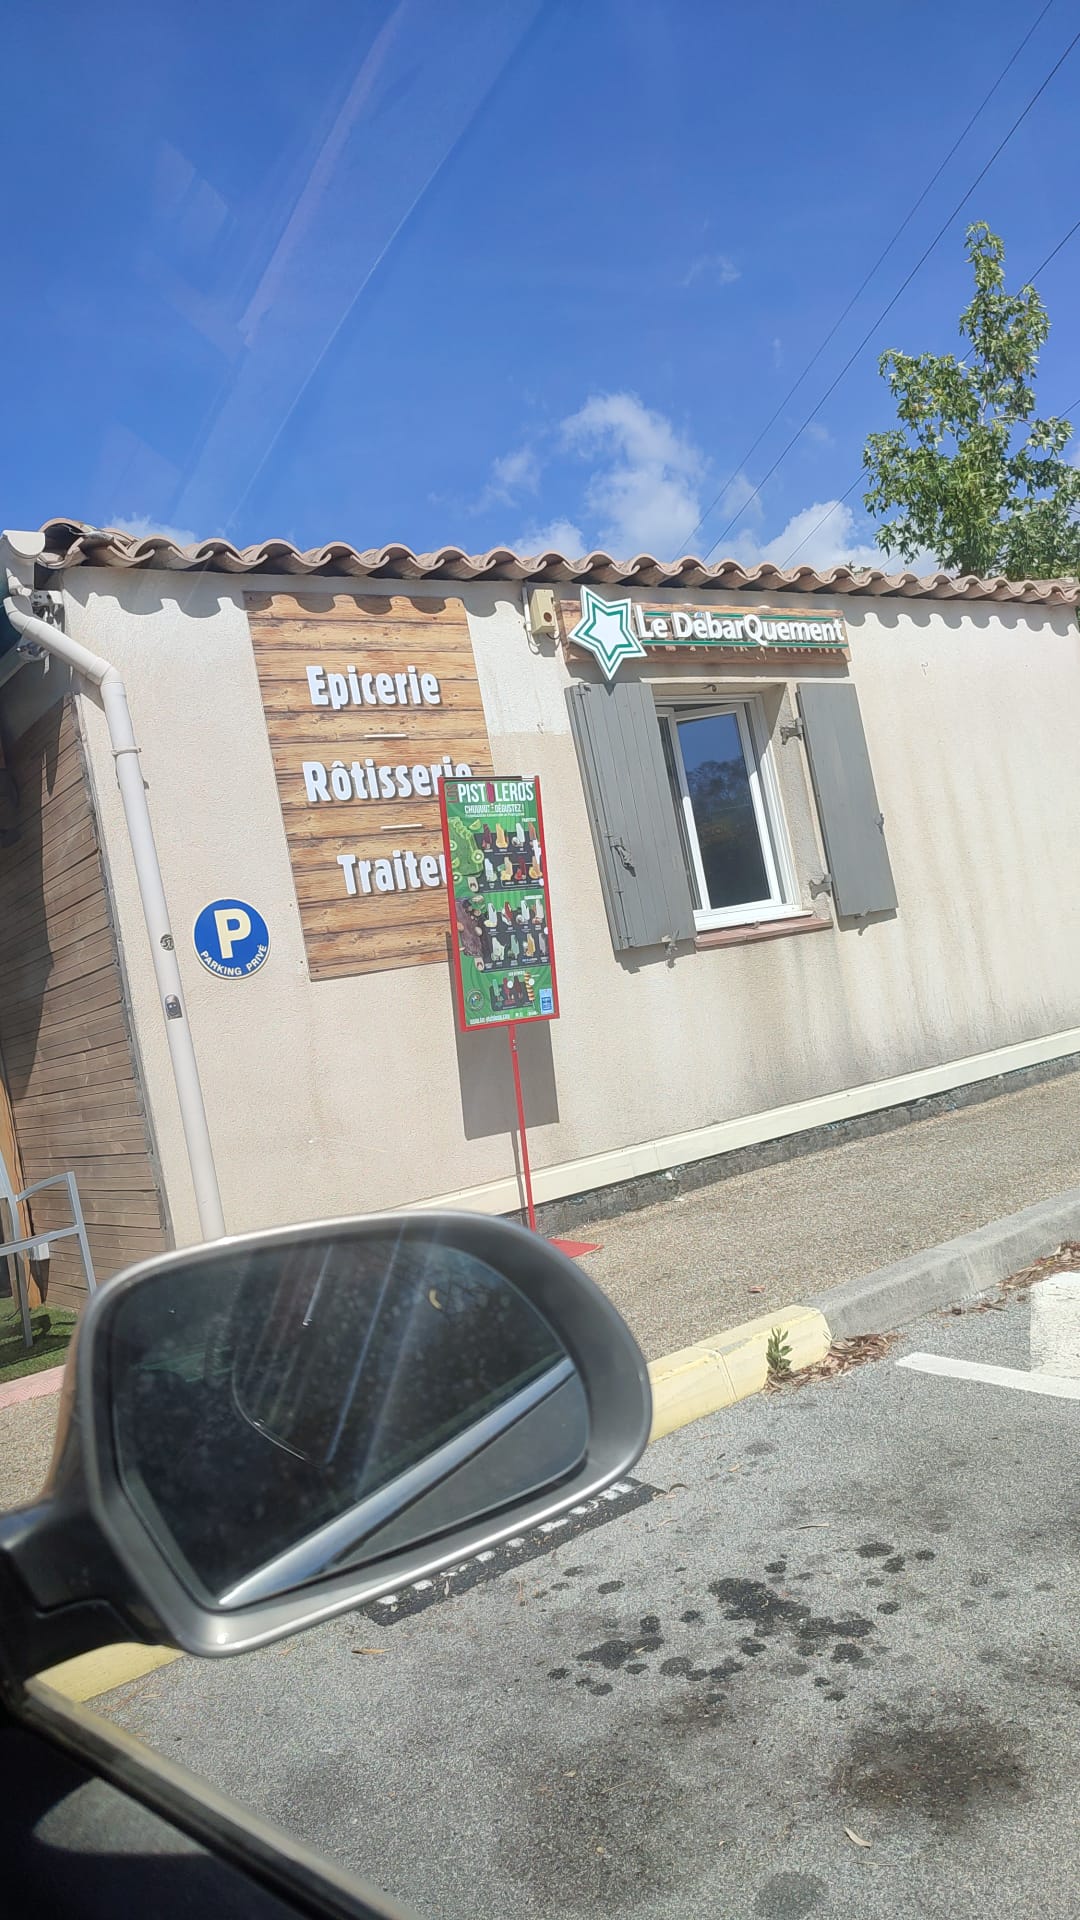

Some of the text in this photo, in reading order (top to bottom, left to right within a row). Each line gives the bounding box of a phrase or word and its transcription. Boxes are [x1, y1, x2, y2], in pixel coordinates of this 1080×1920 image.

[634, 605, 845, 646] Le DébarQuement
[305, 665, 441, 710] Epicerie
[213, 908, 252, 959] P
[200, 943, 268, 976] PARKING PRIVÉ
